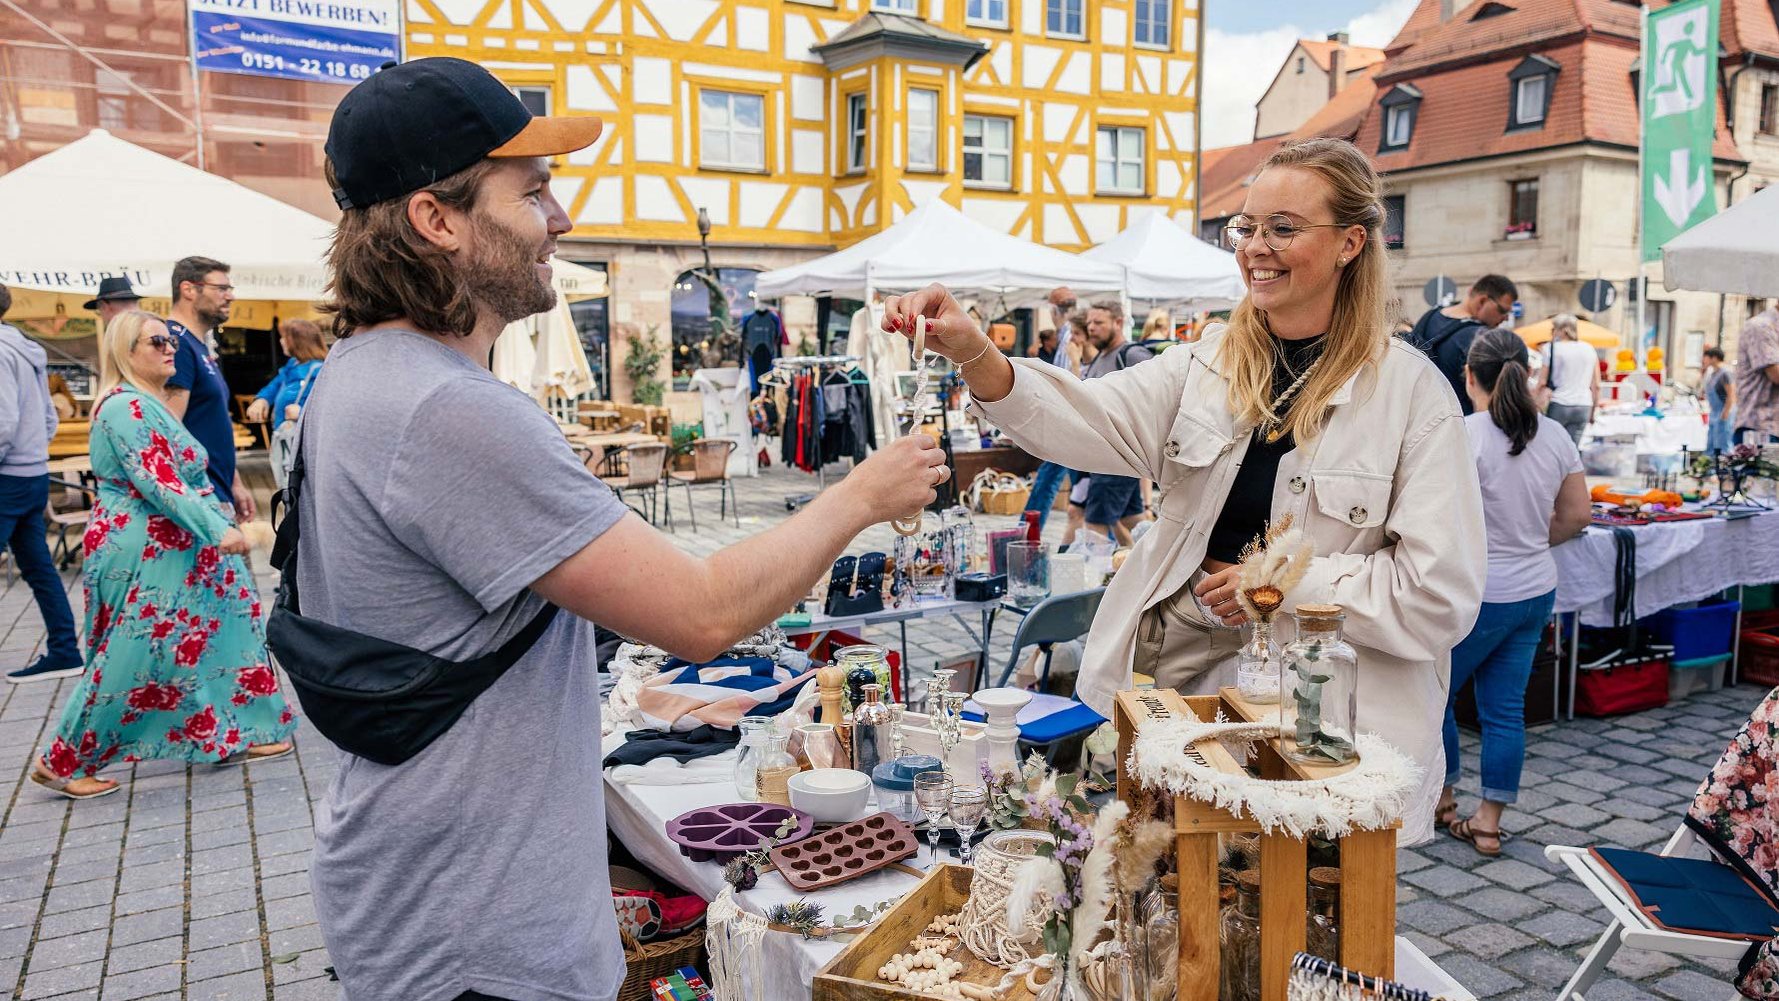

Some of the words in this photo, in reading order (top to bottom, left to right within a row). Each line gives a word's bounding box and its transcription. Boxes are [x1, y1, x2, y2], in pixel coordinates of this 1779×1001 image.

[270, 0, 387, 26] BEWERBEN!
[242, 51, 284, 71] 0151
[300, 58, 321, 75] 22
[326, 61, 346, 77] 18
[350, 63, 370, 79] 68
